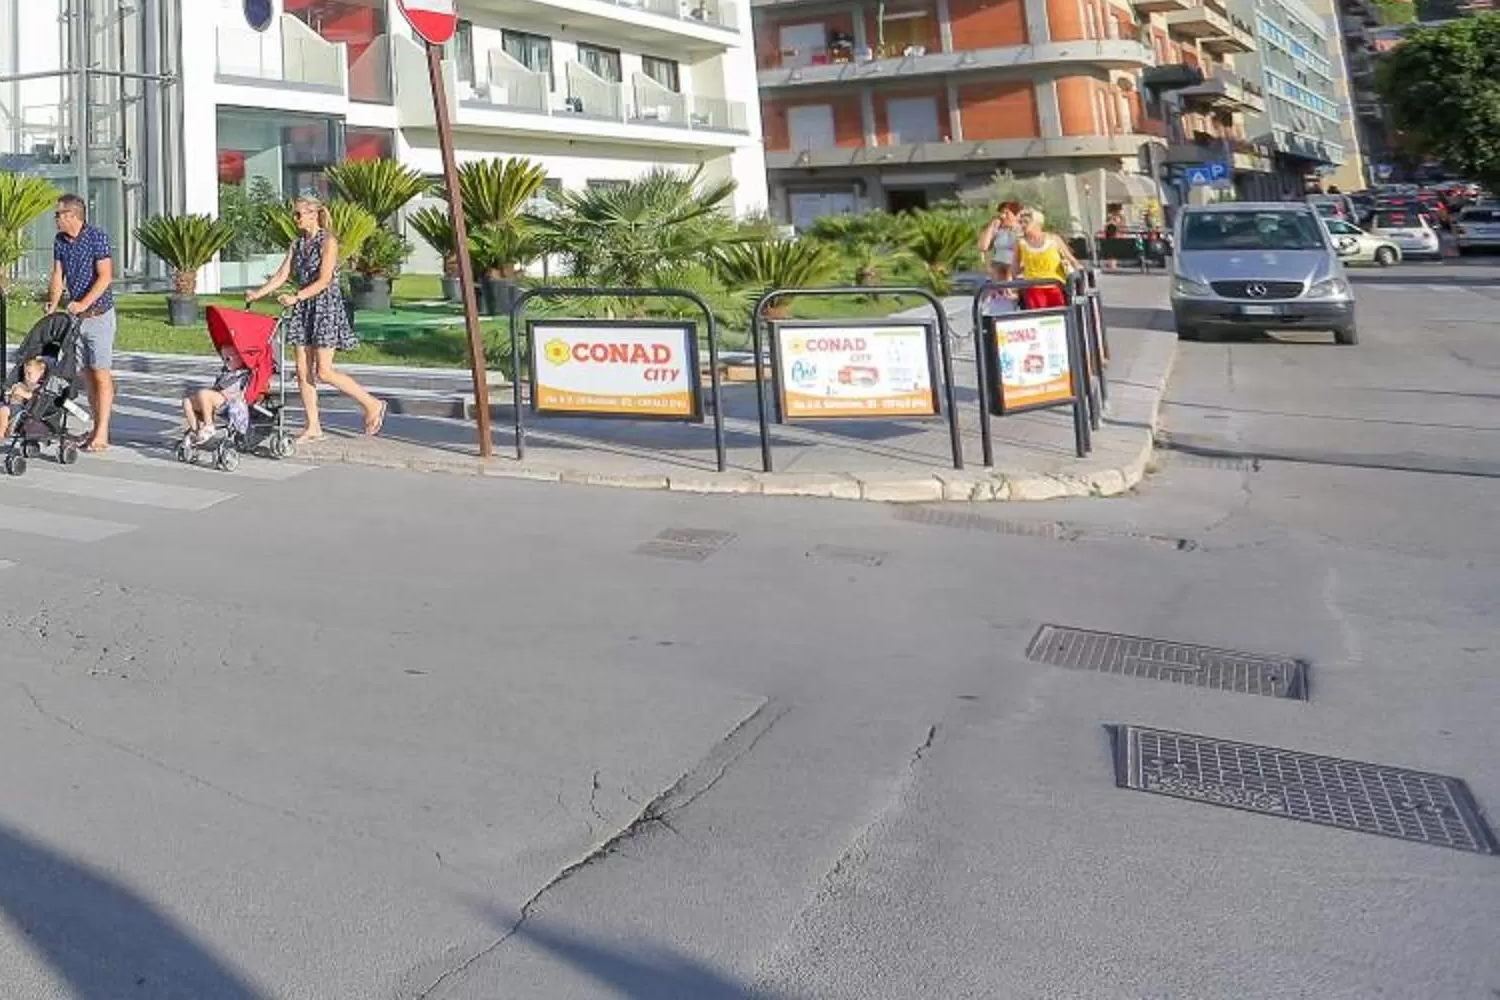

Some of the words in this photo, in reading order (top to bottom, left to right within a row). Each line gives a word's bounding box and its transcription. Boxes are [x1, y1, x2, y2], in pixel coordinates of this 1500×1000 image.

[805, 337, 867, 353] CONAD
[571, 342, 672, 365] CONAD
[849, 353, 873, 363] CITY
[643, 367, 681, 382] CITY
